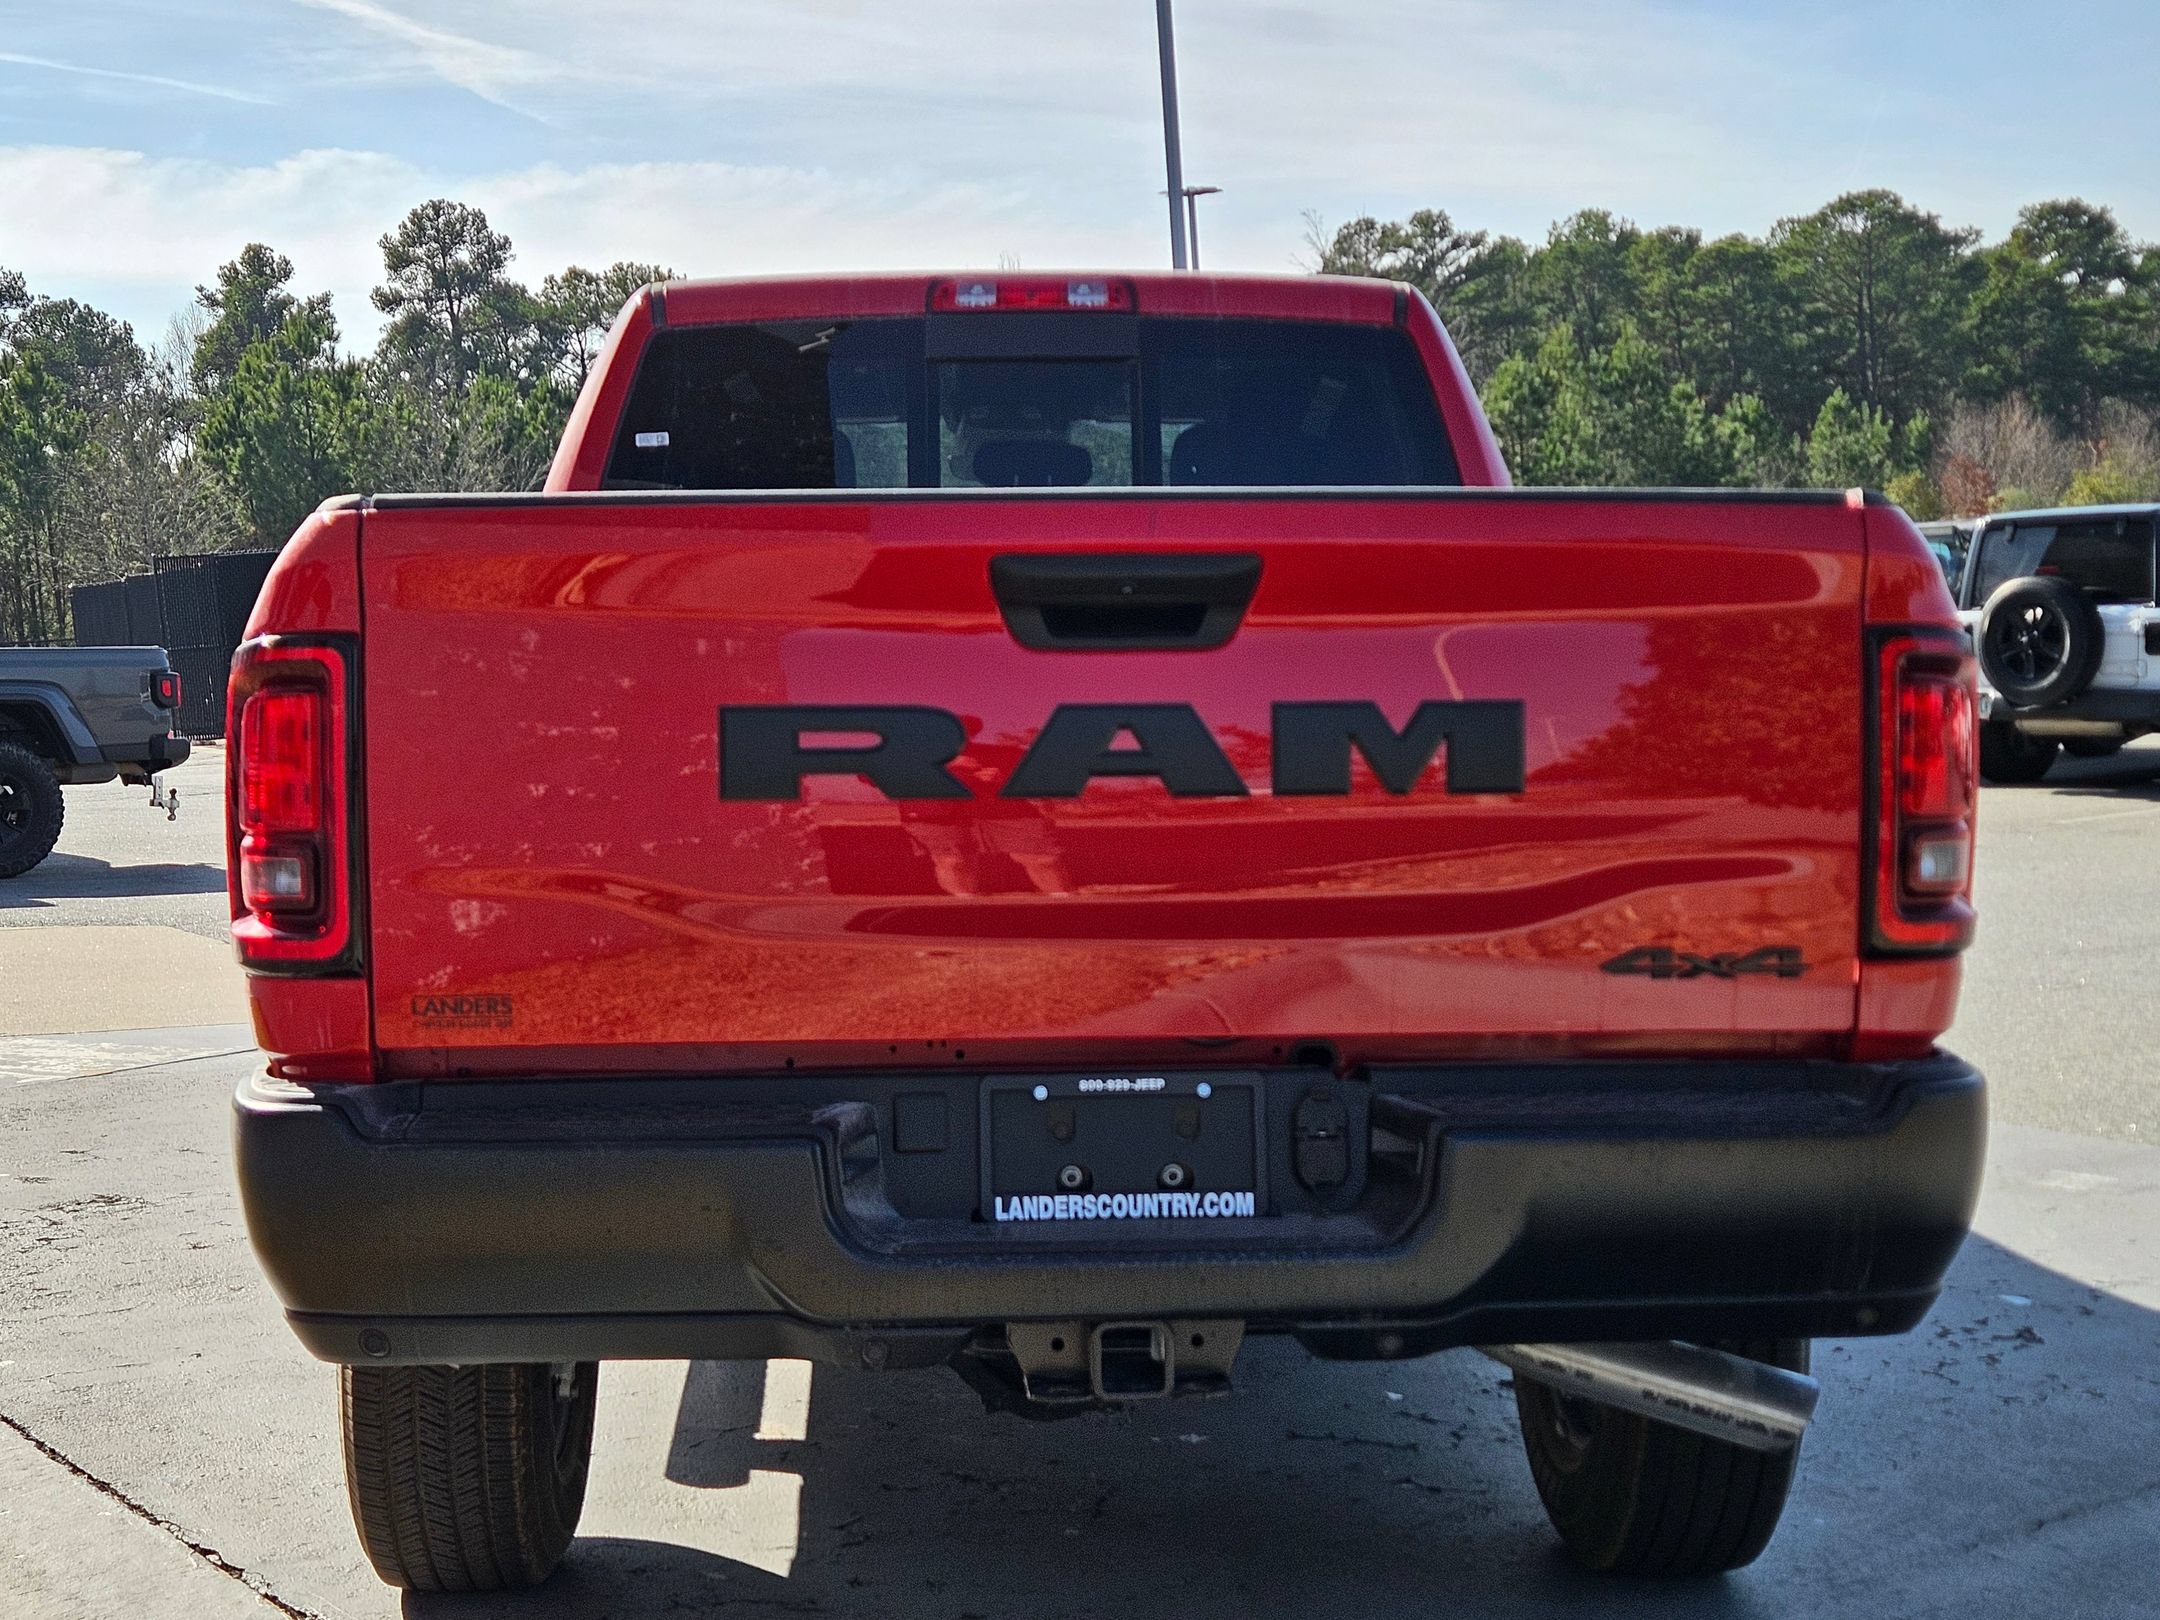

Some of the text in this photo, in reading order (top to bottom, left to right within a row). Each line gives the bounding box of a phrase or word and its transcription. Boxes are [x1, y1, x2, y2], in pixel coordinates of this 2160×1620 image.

[718, 699, 1525, 799] RAM
[1600, 946, 1804, 979] 4x4
[411, 997, 512, 1015] LANDERS
[994, 1192, 1255, 1221] LANDERSCOUNTRY.COM
